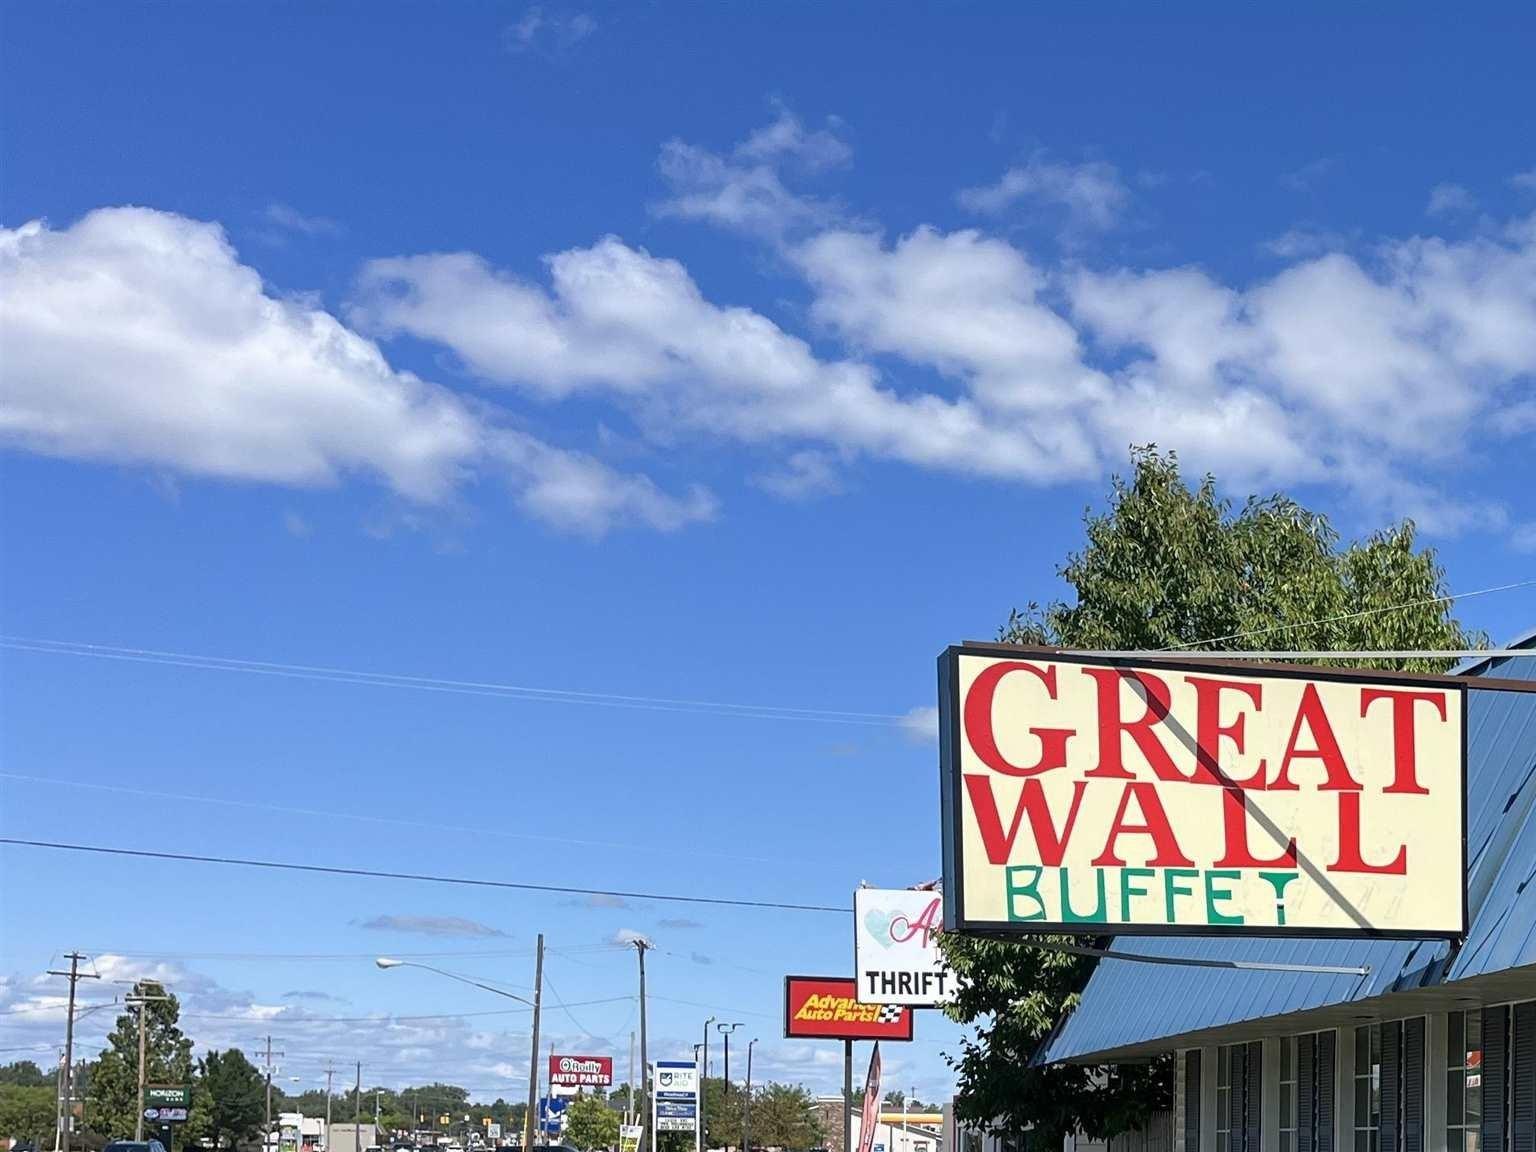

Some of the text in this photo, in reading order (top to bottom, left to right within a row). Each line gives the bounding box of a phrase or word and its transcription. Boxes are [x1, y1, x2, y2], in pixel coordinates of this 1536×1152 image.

[963, 660, 1448, 796] GREAT
[963, 773, 1407, 876] WALL
[1005, 865, 1299, 926] BUFFET
[866, 971, 948, 995] THRIFT
[794, 1007, 833, 1021] Auto
[552, 1073, 609, 1084] AUTO PARTS
